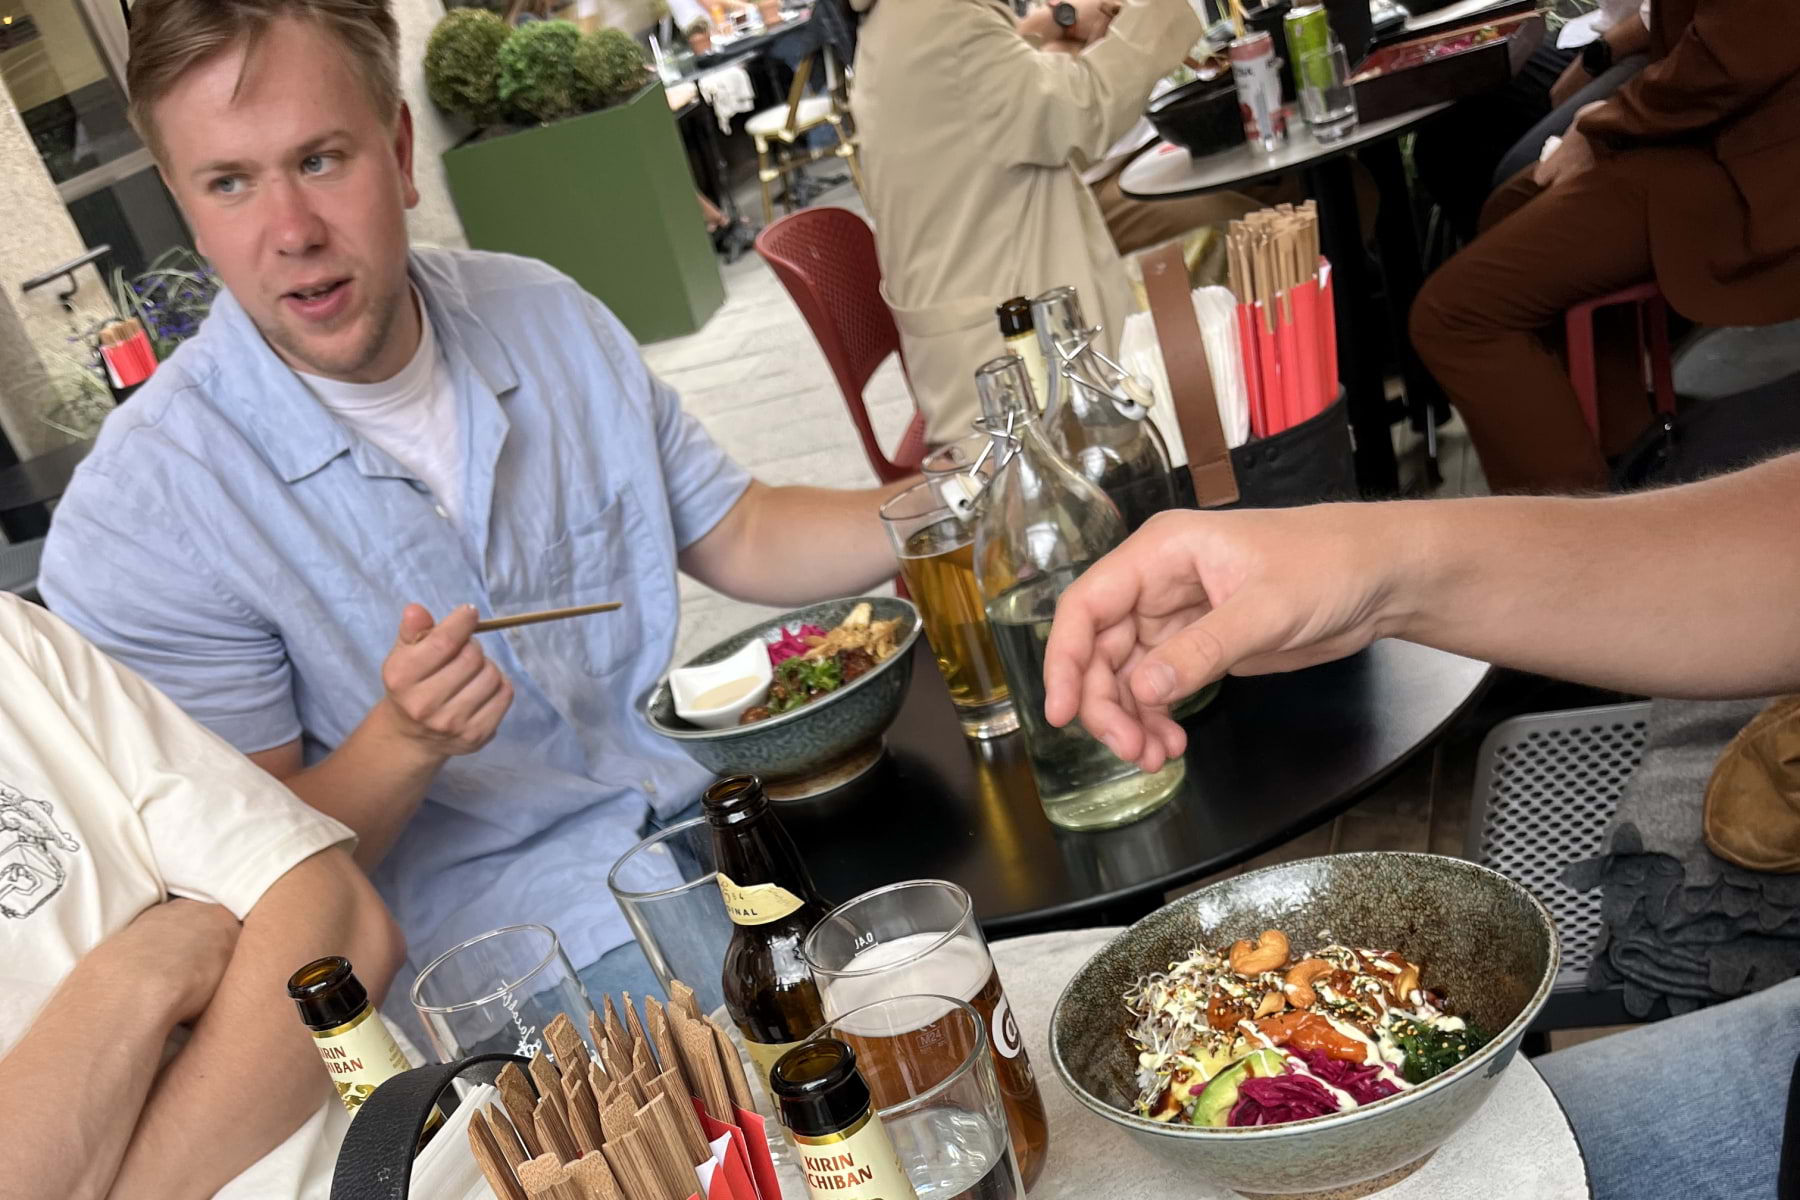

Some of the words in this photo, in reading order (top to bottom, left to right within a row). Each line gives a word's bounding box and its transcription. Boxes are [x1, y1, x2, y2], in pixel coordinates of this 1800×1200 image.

[319, 1046, 347, 1060] IRIN
[326, 1057, 364, 1074] HIBAN
[804, 1152, 855, 1172] KIRIN
